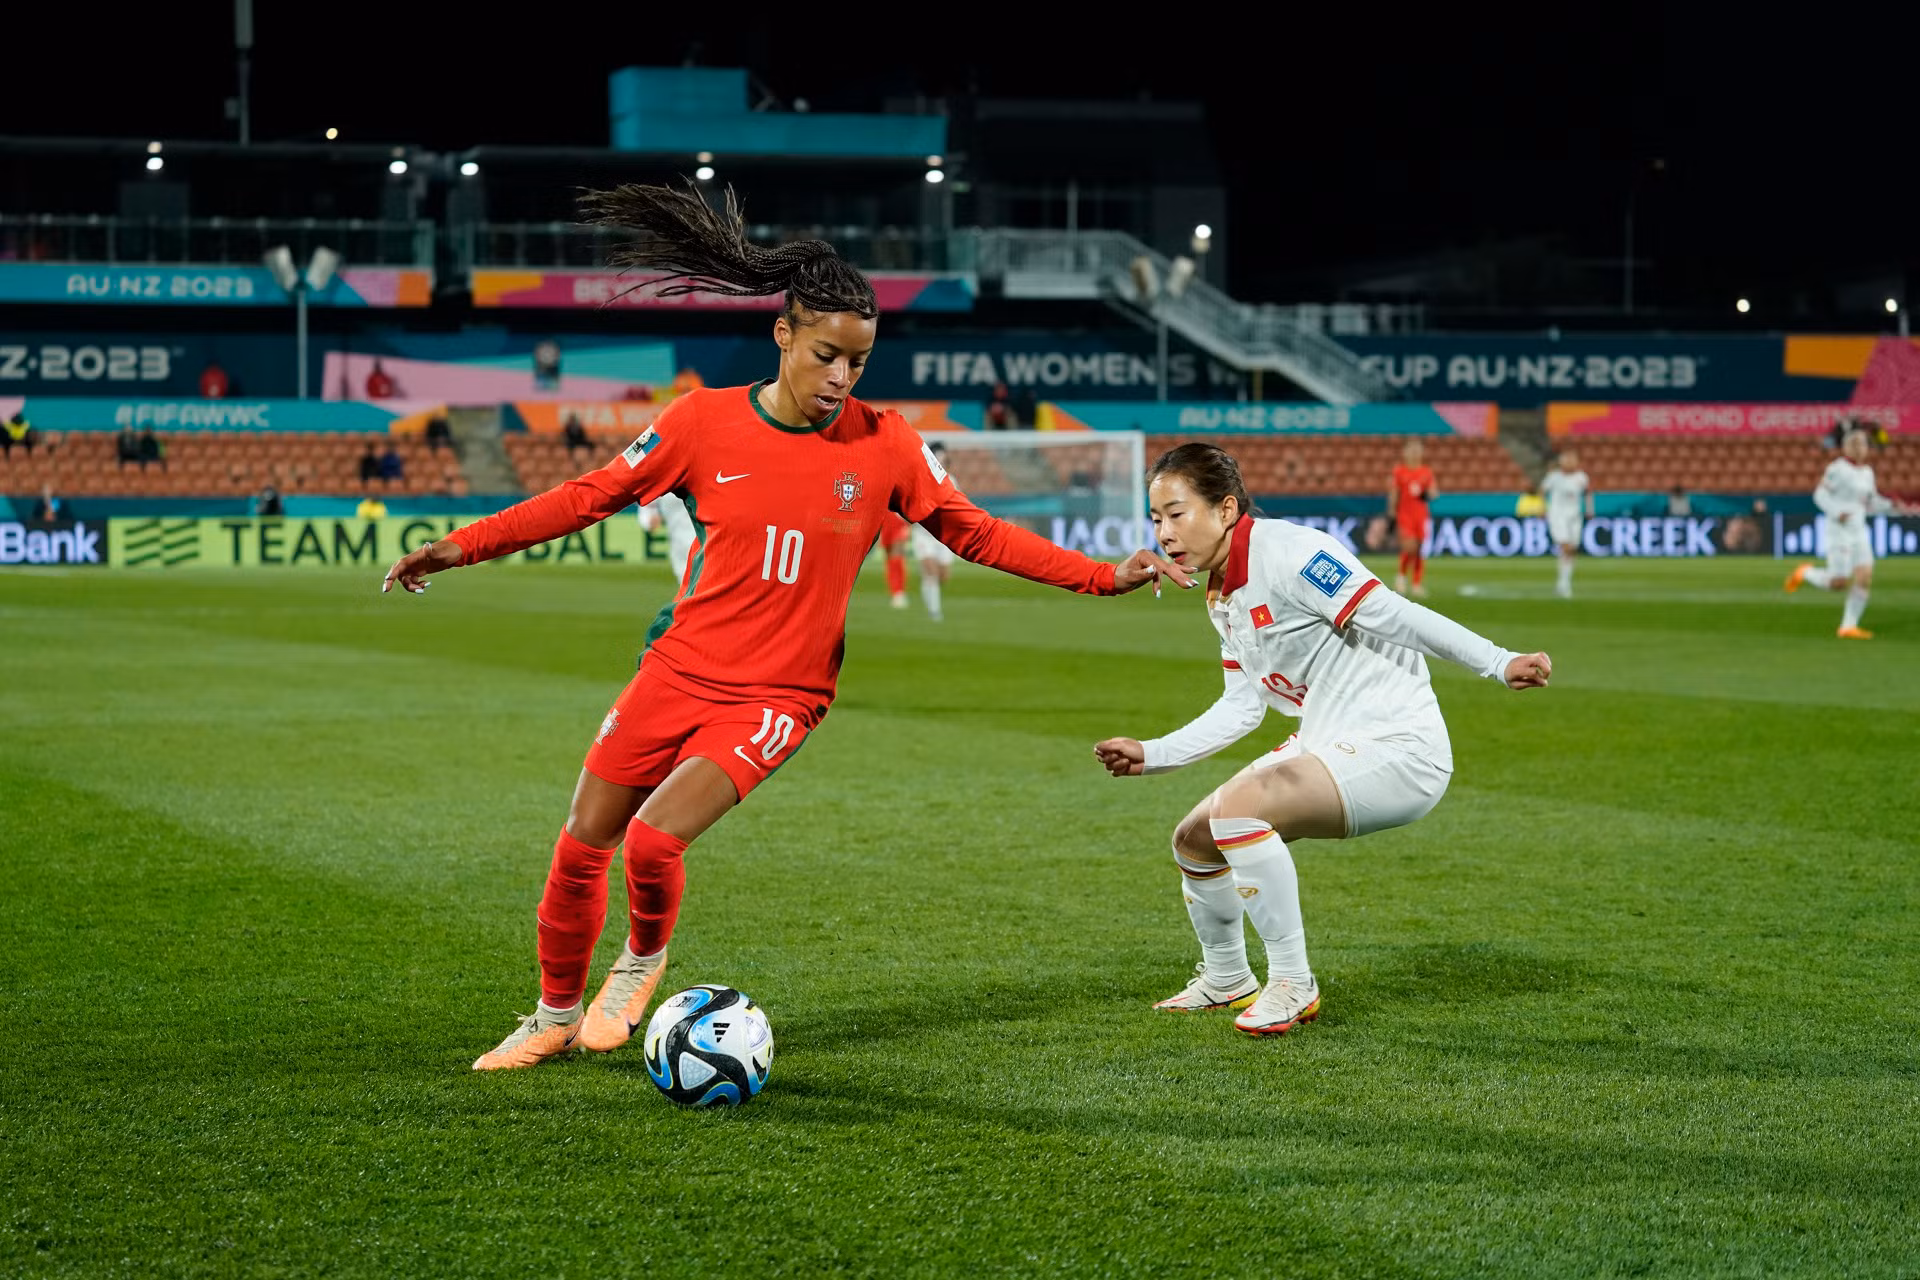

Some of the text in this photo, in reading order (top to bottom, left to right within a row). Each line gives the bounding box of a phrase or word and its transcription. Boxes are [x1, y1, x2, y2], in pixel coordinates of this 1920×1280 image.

[170, 275, 255, 297] 2023
[912, 353, 997, 385] FIFA
[1004, 352, 1197, 386] WOMENS
[1638, 405, 1744, 429] BEYOND
[0, 521, 99, 563] Bank
[220, 520, 378, 563] TEAM
[762, 525, 804, 584] 10
[1420, 516, 1717, 558] JACOB CREEK
[750, 707, 795, 761] 10
